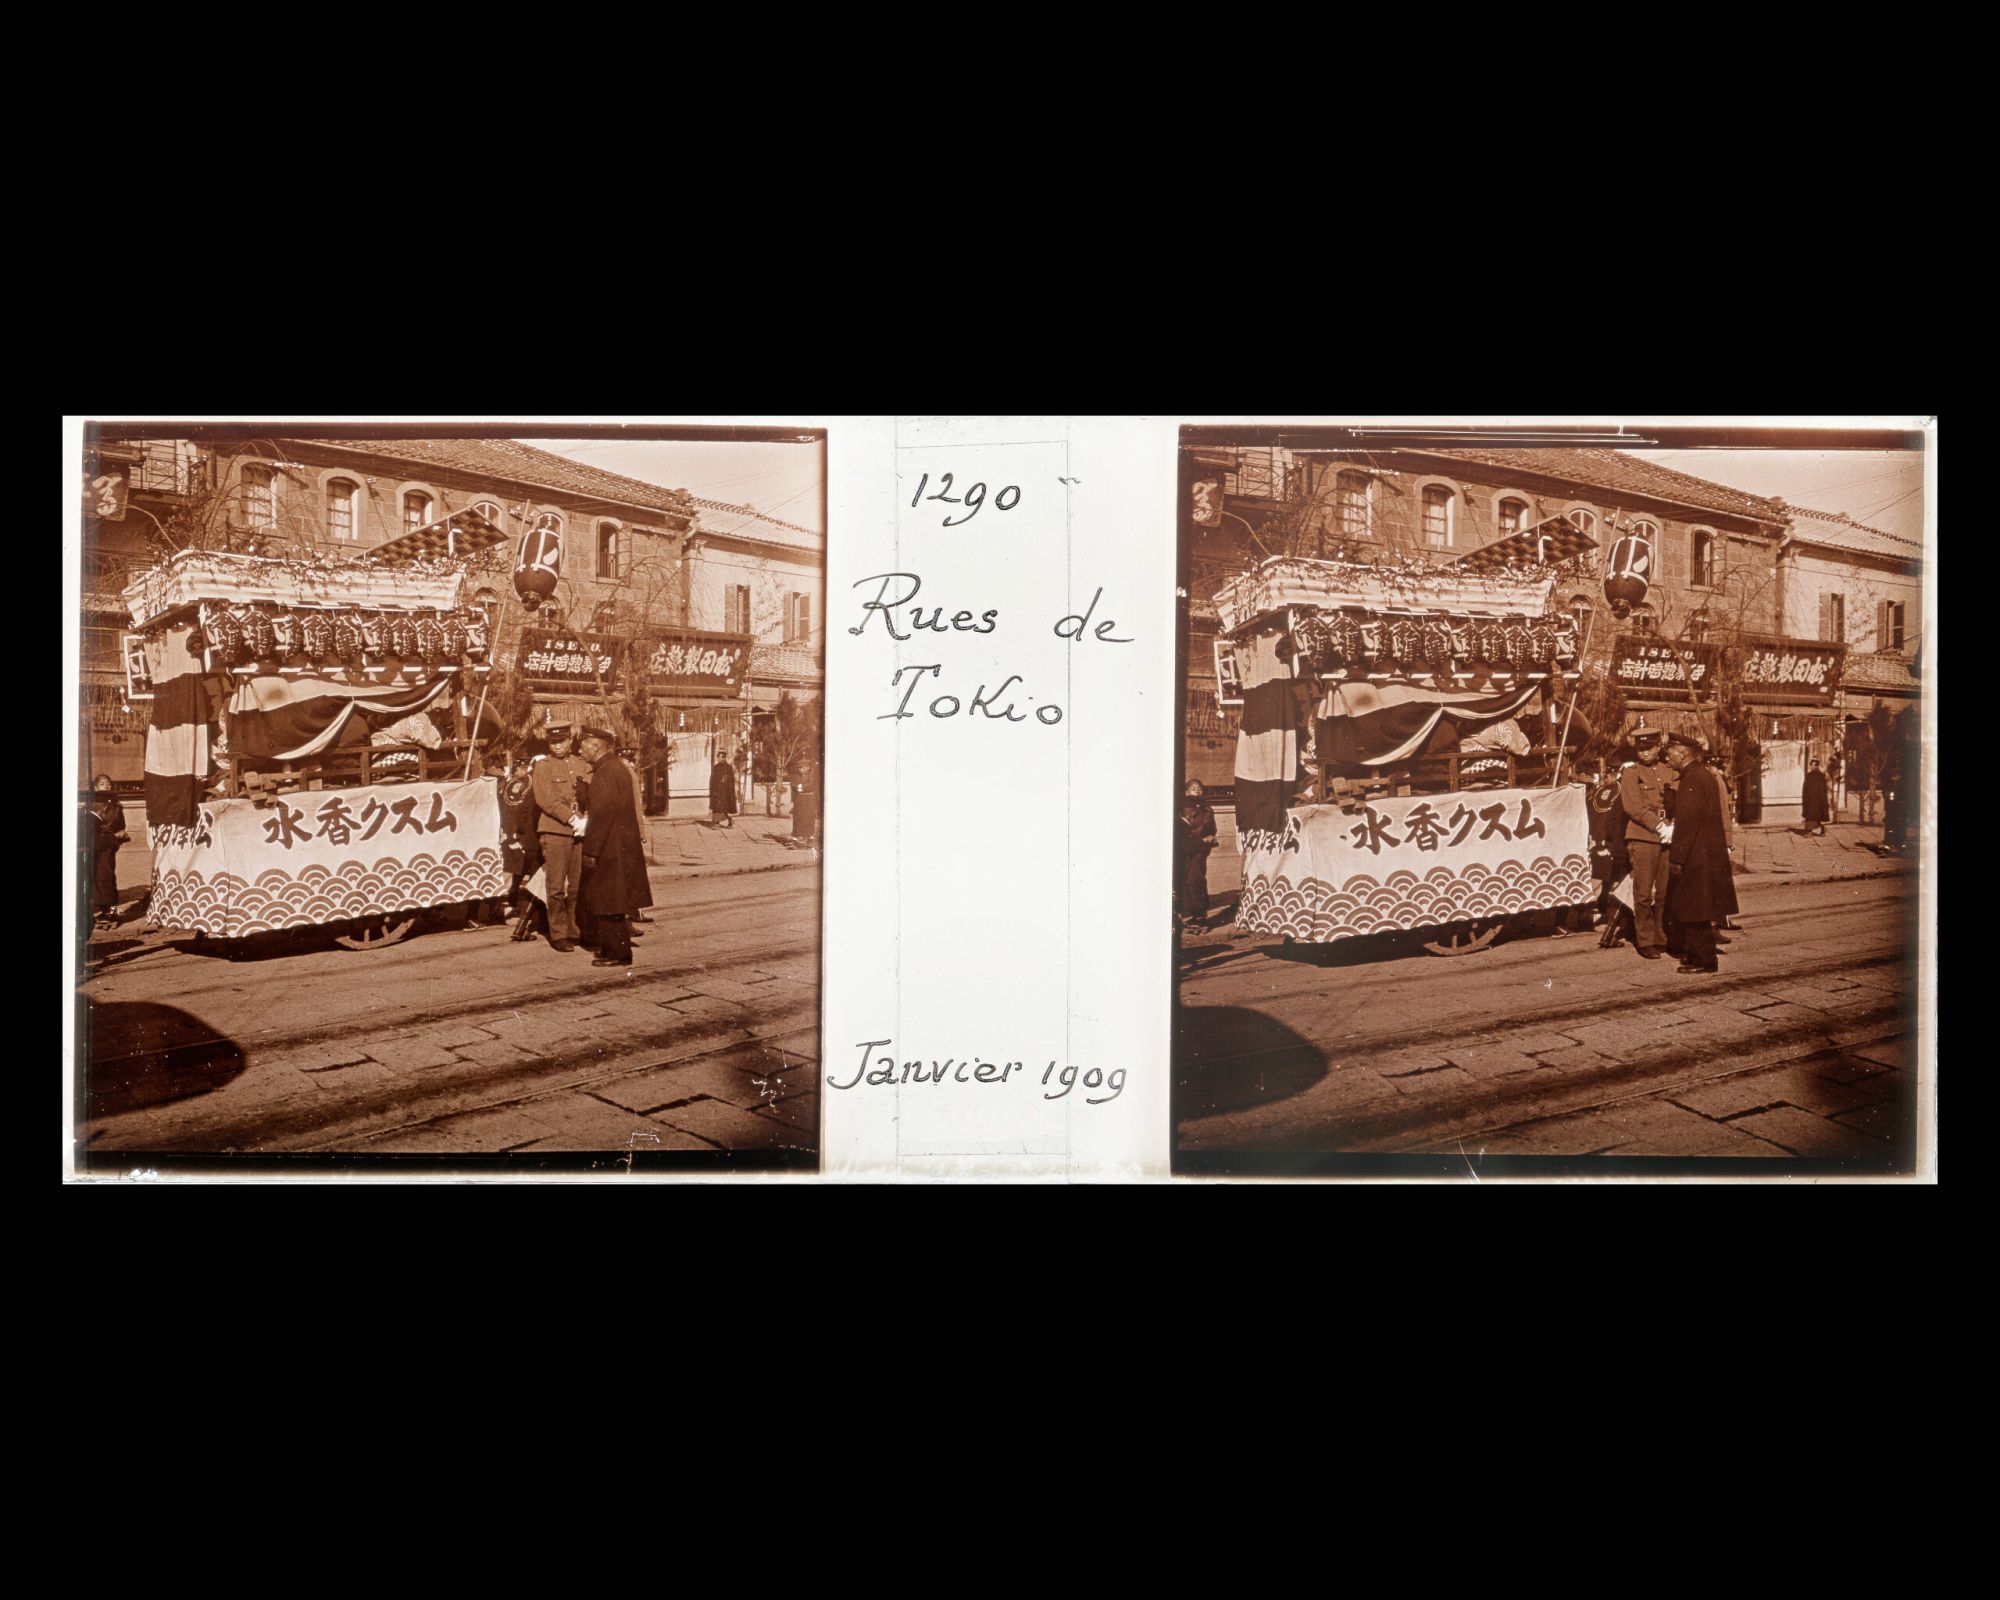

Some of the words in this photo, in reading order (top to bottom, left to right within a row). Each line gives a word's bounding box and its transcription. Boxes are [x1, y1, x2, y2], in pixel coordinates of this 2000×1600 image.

[912, 473, 1021, 527] 1290
[848, 573, 998, 640] Rues
[1054, 587, 1135, 642] de
[827, 1039, 1023, 1089] Janvier
[1041, 1061, 1127, 1104] 1909
